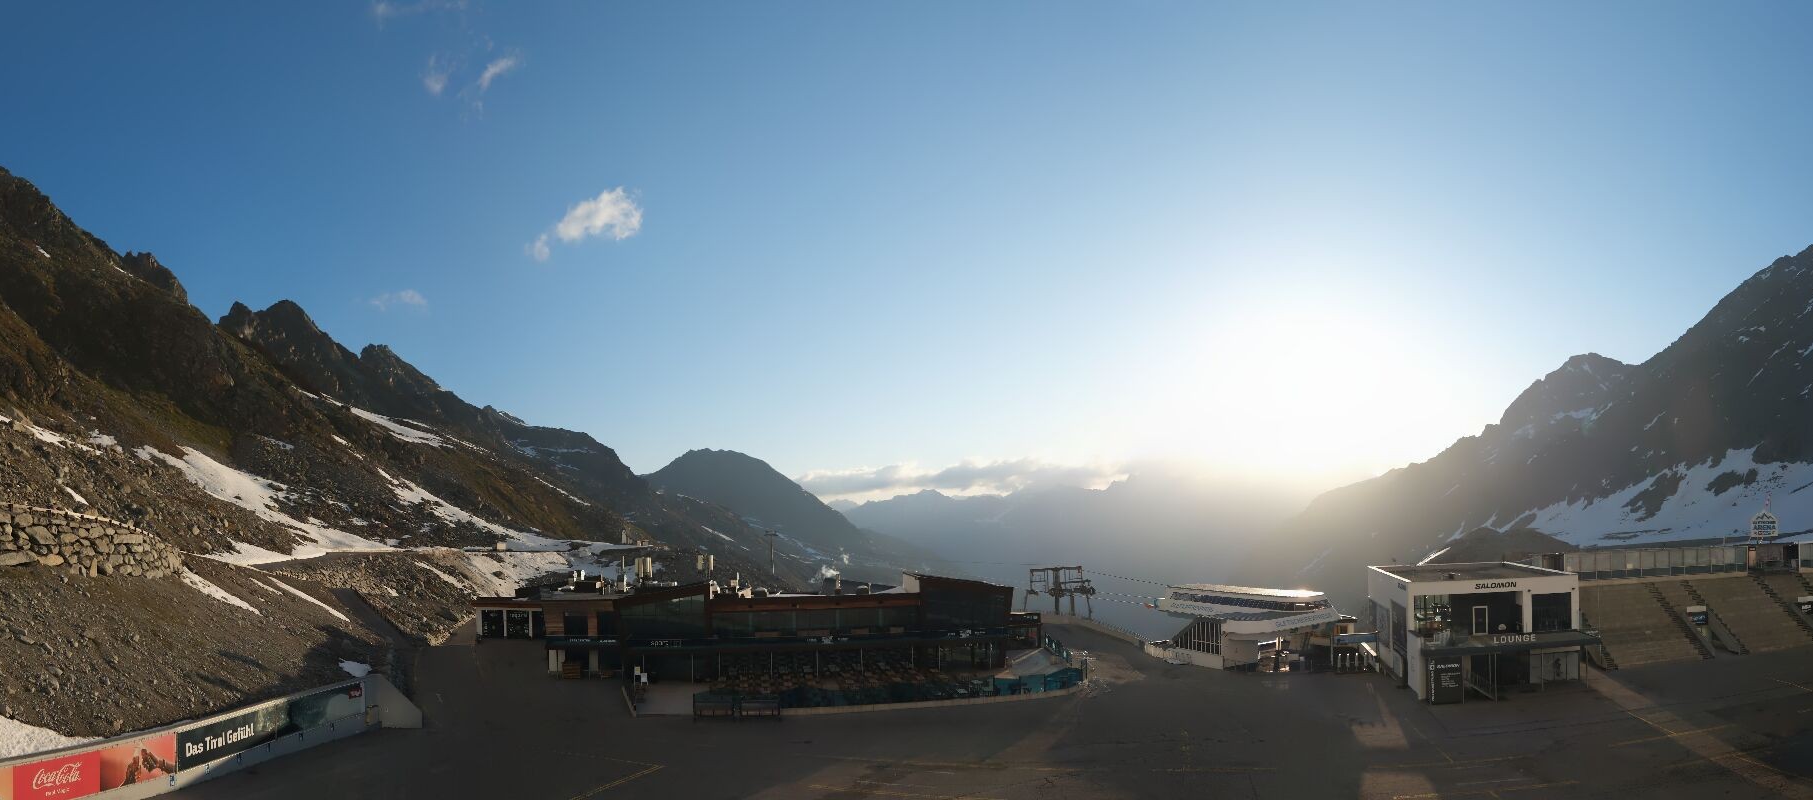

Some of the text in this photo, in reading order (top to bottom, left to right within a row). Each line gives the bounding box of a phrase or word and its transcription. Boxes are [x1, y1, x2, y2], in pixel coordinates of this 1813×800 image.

[1474, 581, 1517, 590] SALOMON
[1493, 634, 1537, 644] LOUNGE
[185, 722, 255, 757] Das Tirol Gefühl
